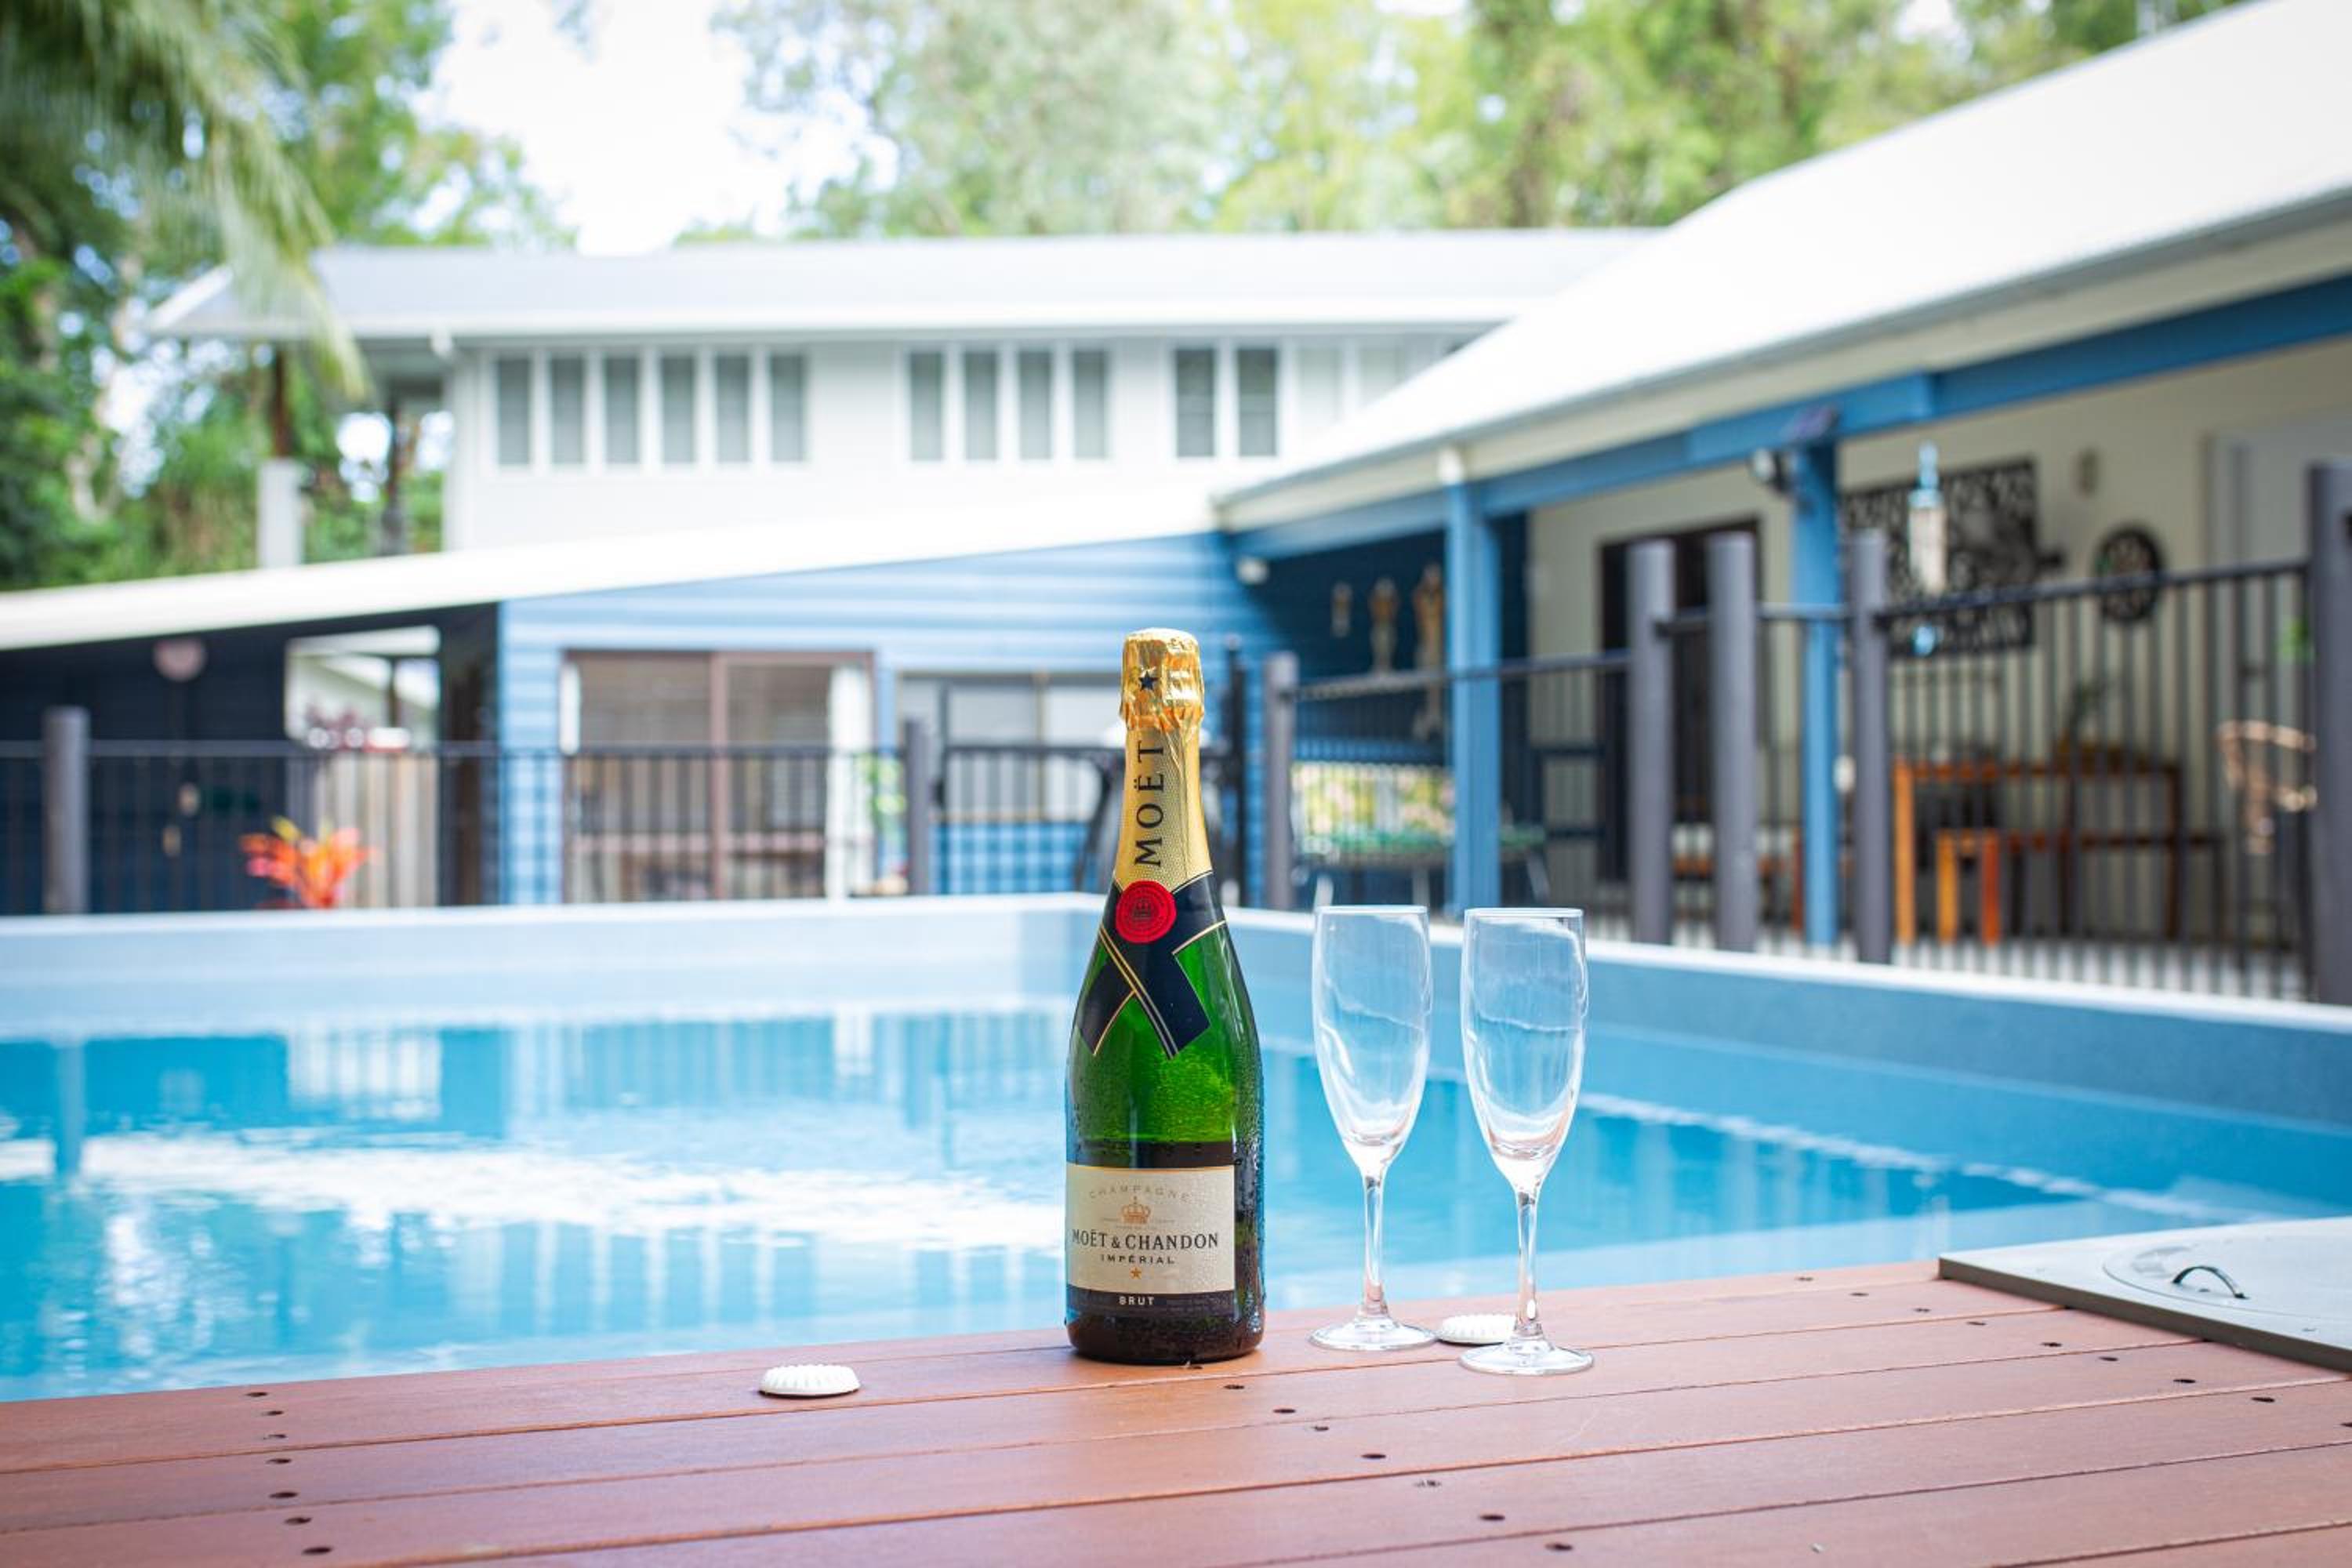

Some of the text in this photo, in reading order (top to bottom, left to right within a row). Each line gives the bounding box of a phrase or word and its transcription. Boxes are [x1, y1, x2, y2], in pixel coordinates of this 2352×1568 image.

[1134, 741, 1164, 866] MOËT
[1072, 1229, 1218, 1250] MOËT & CHANDON
[1119, 1296, 1155, 1305] BRUT
